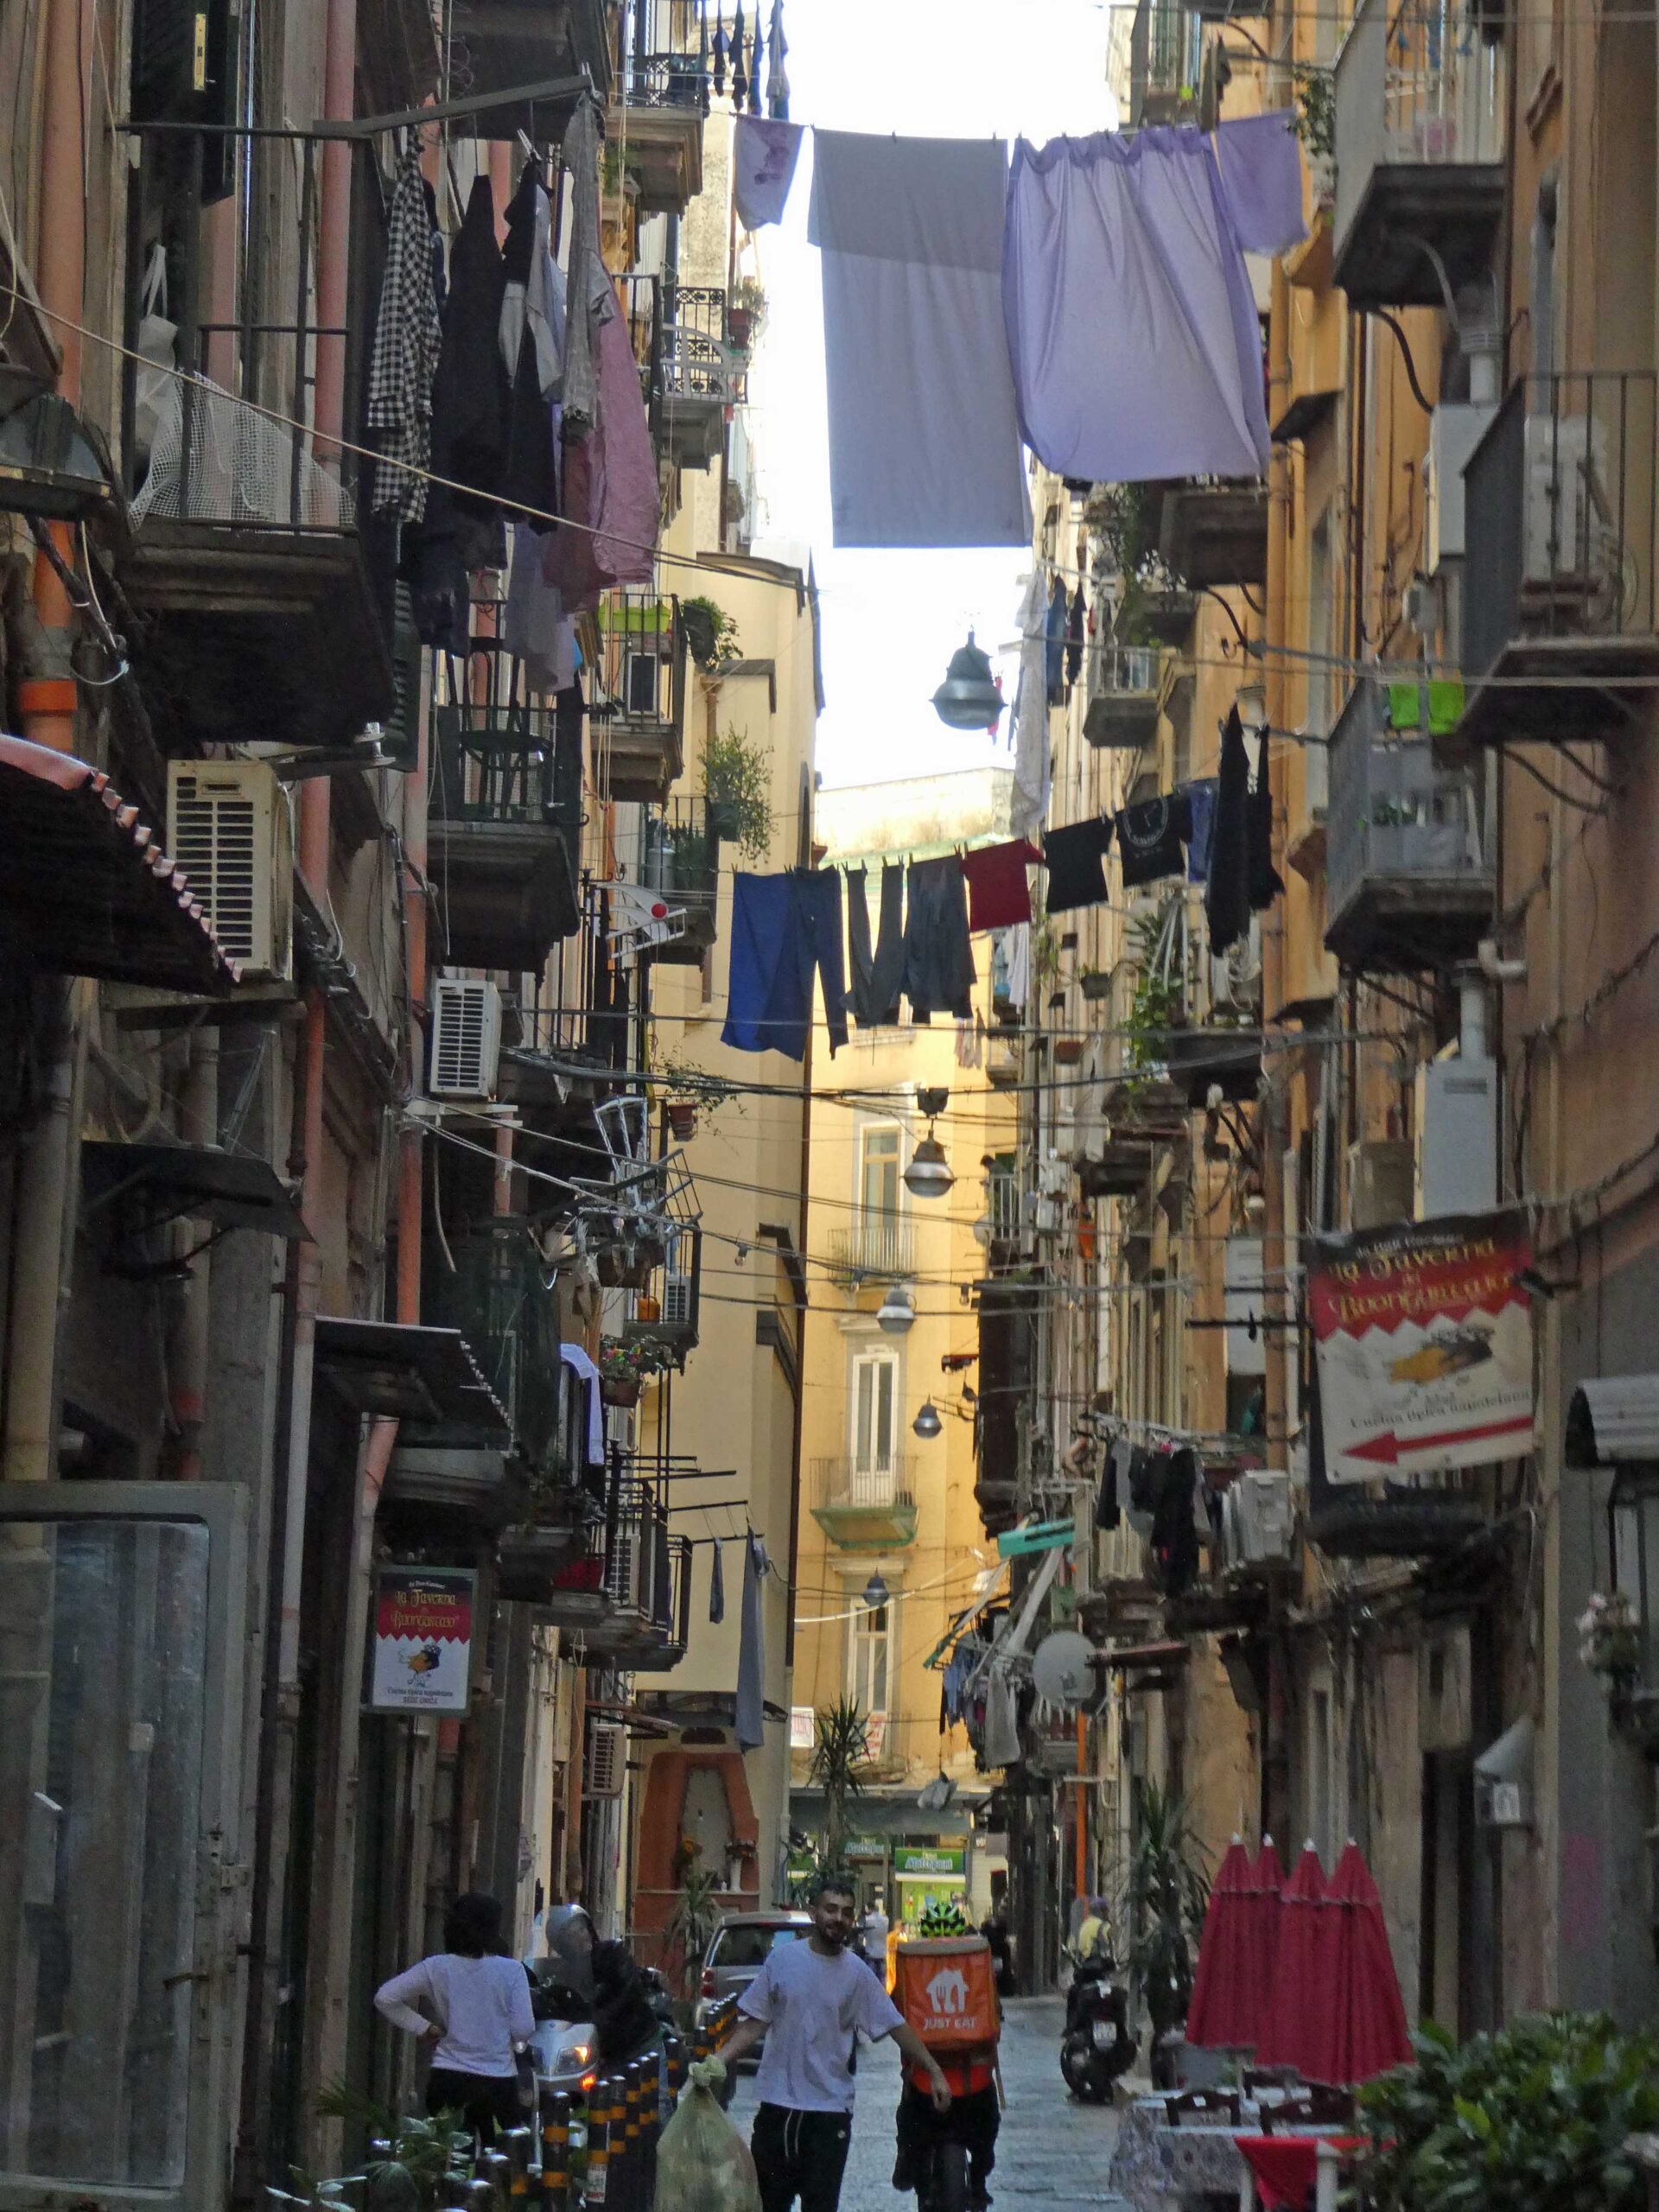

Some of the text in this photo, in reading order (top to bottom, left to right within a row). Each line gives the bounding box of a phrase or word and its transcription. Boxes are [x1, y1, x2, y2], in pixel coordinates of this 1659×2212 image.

[1369, 1238, 1495, 1281] Taverna
[410, 1589, 456, 1607] Taverna
[923, 2018, 976, 2031] JUST EAT
